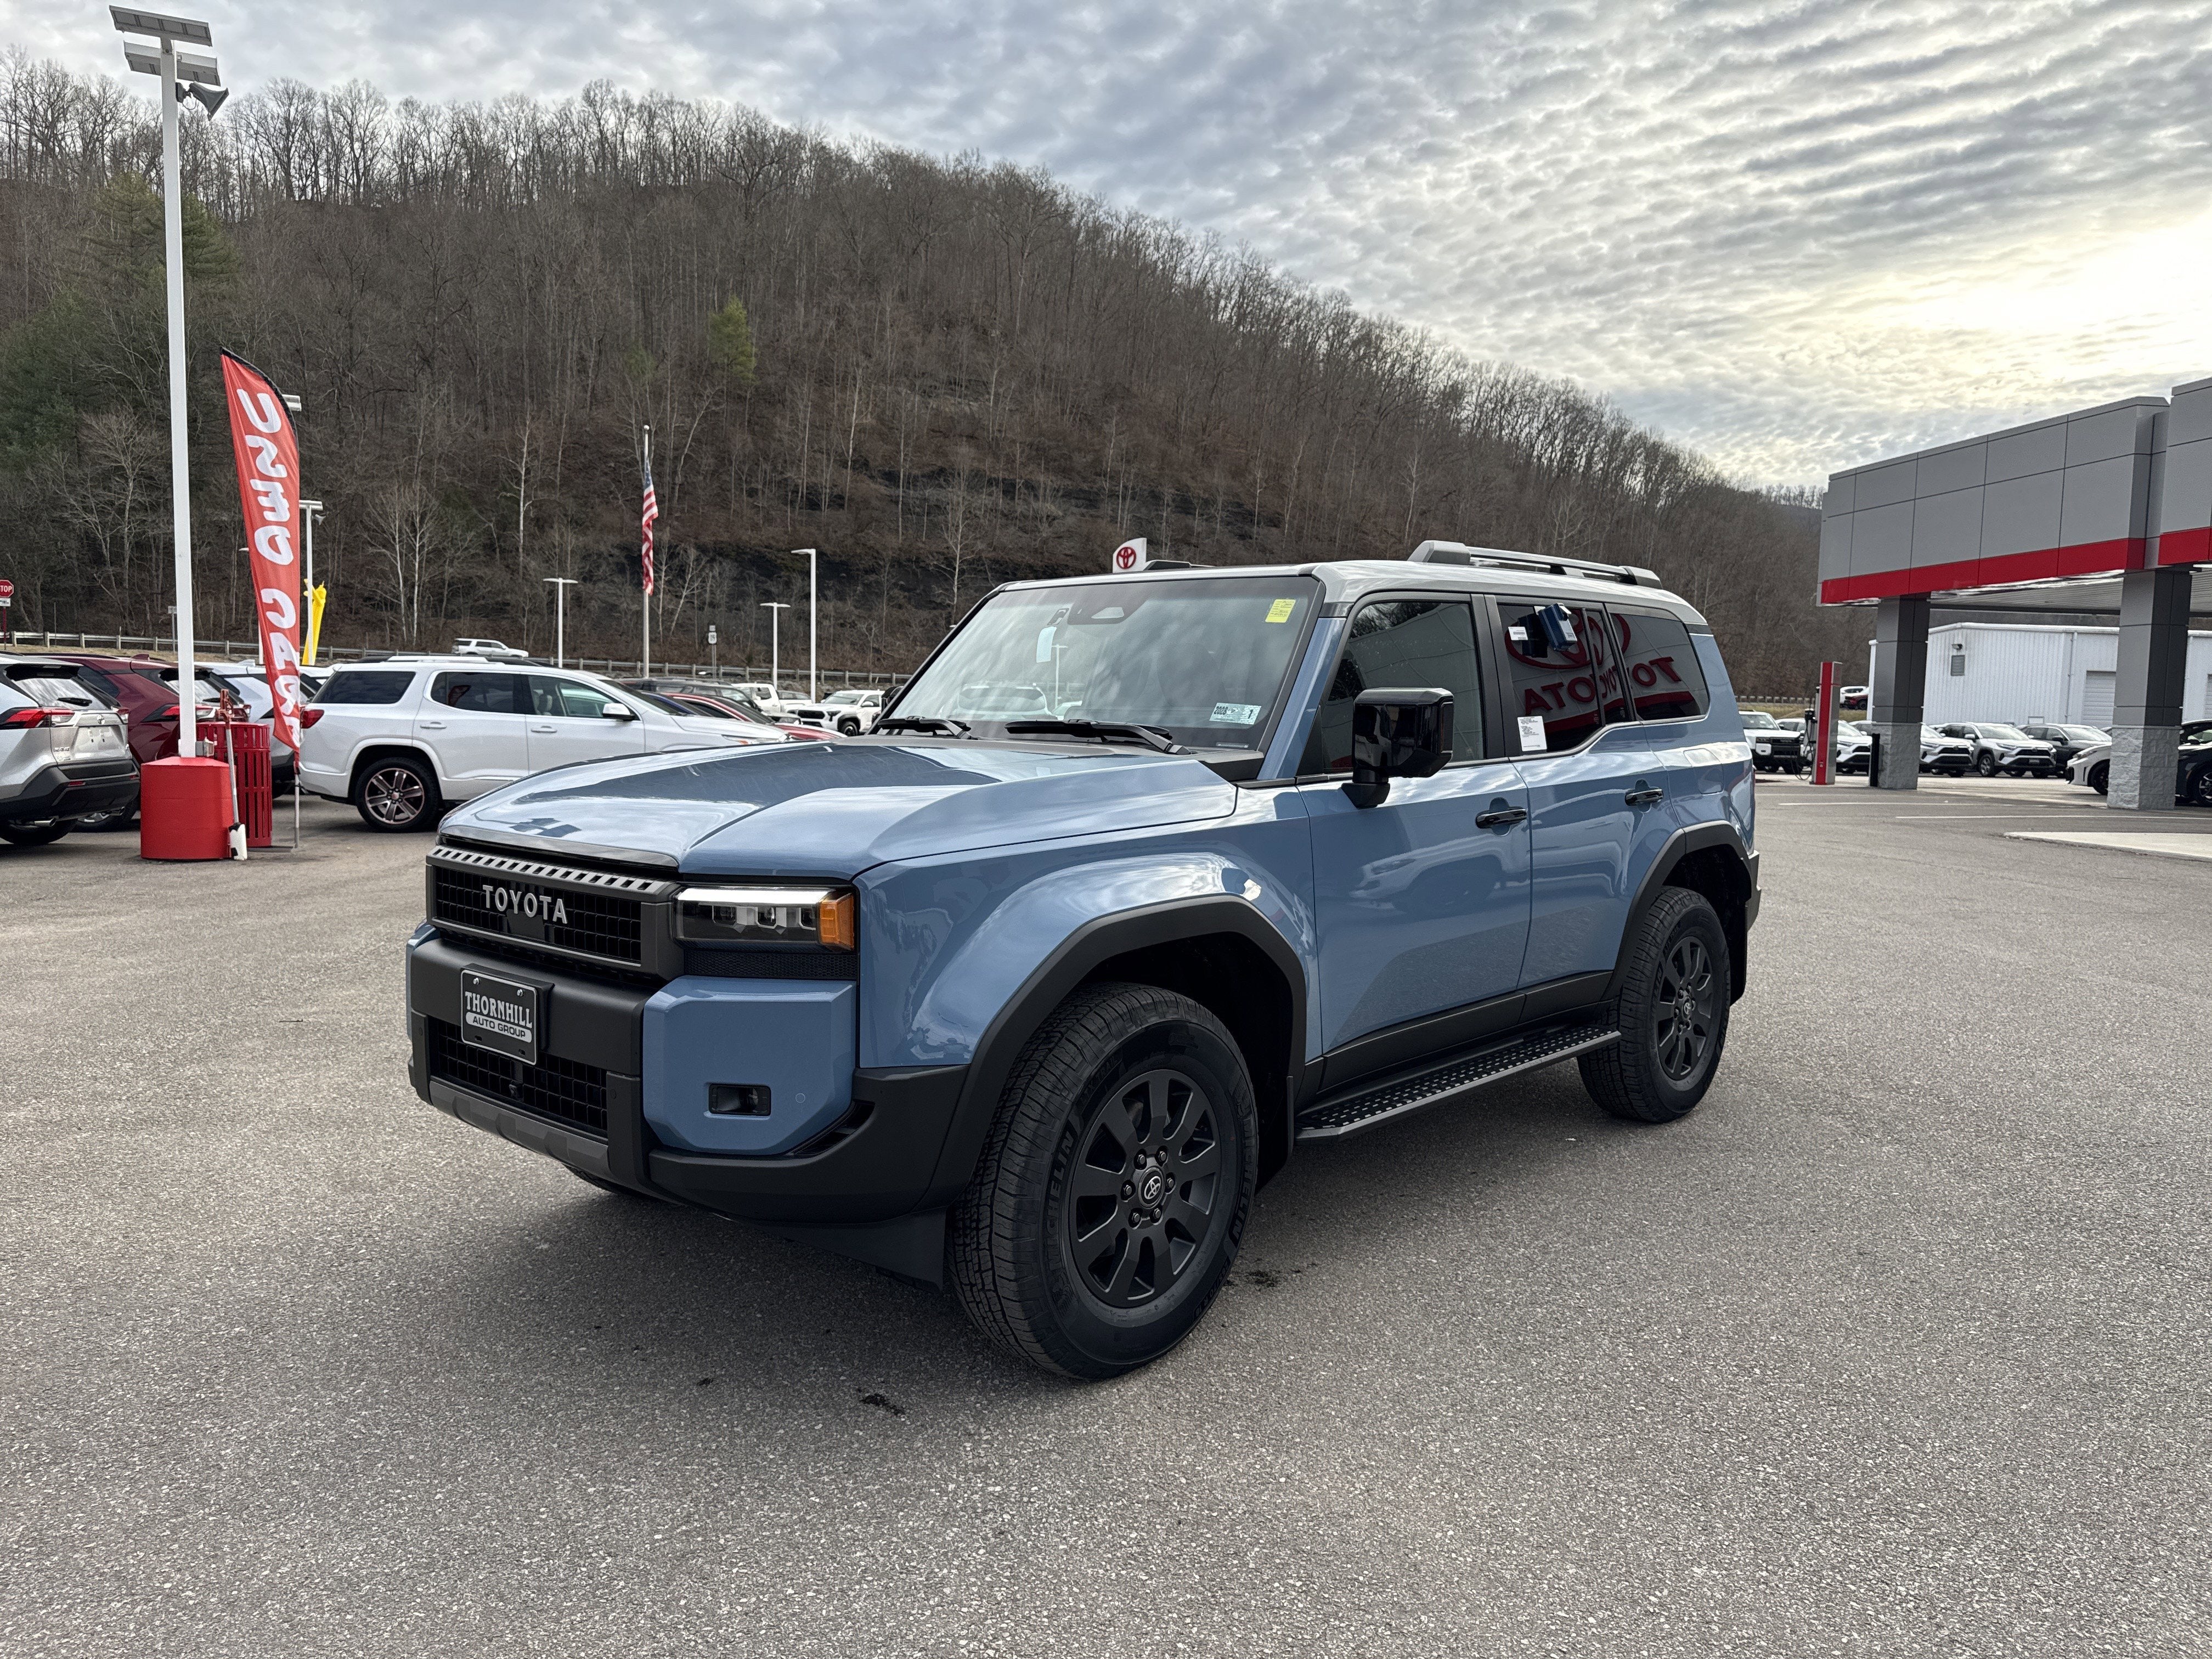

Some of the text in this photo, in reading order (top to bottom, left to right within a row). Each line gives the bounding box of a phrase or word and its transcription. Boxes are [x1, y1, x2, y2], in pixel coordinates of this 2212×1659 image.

[483, 884, 567, 924] TOYOTA
[465, 991, 533, 1029] THORNHILL
[472, 1016, 526, 1038] AUTO GROUP
[1232, 1118, 1255, 1241] MICHELIN
[1046, 1129, 1075, 1271] MICHELIN
